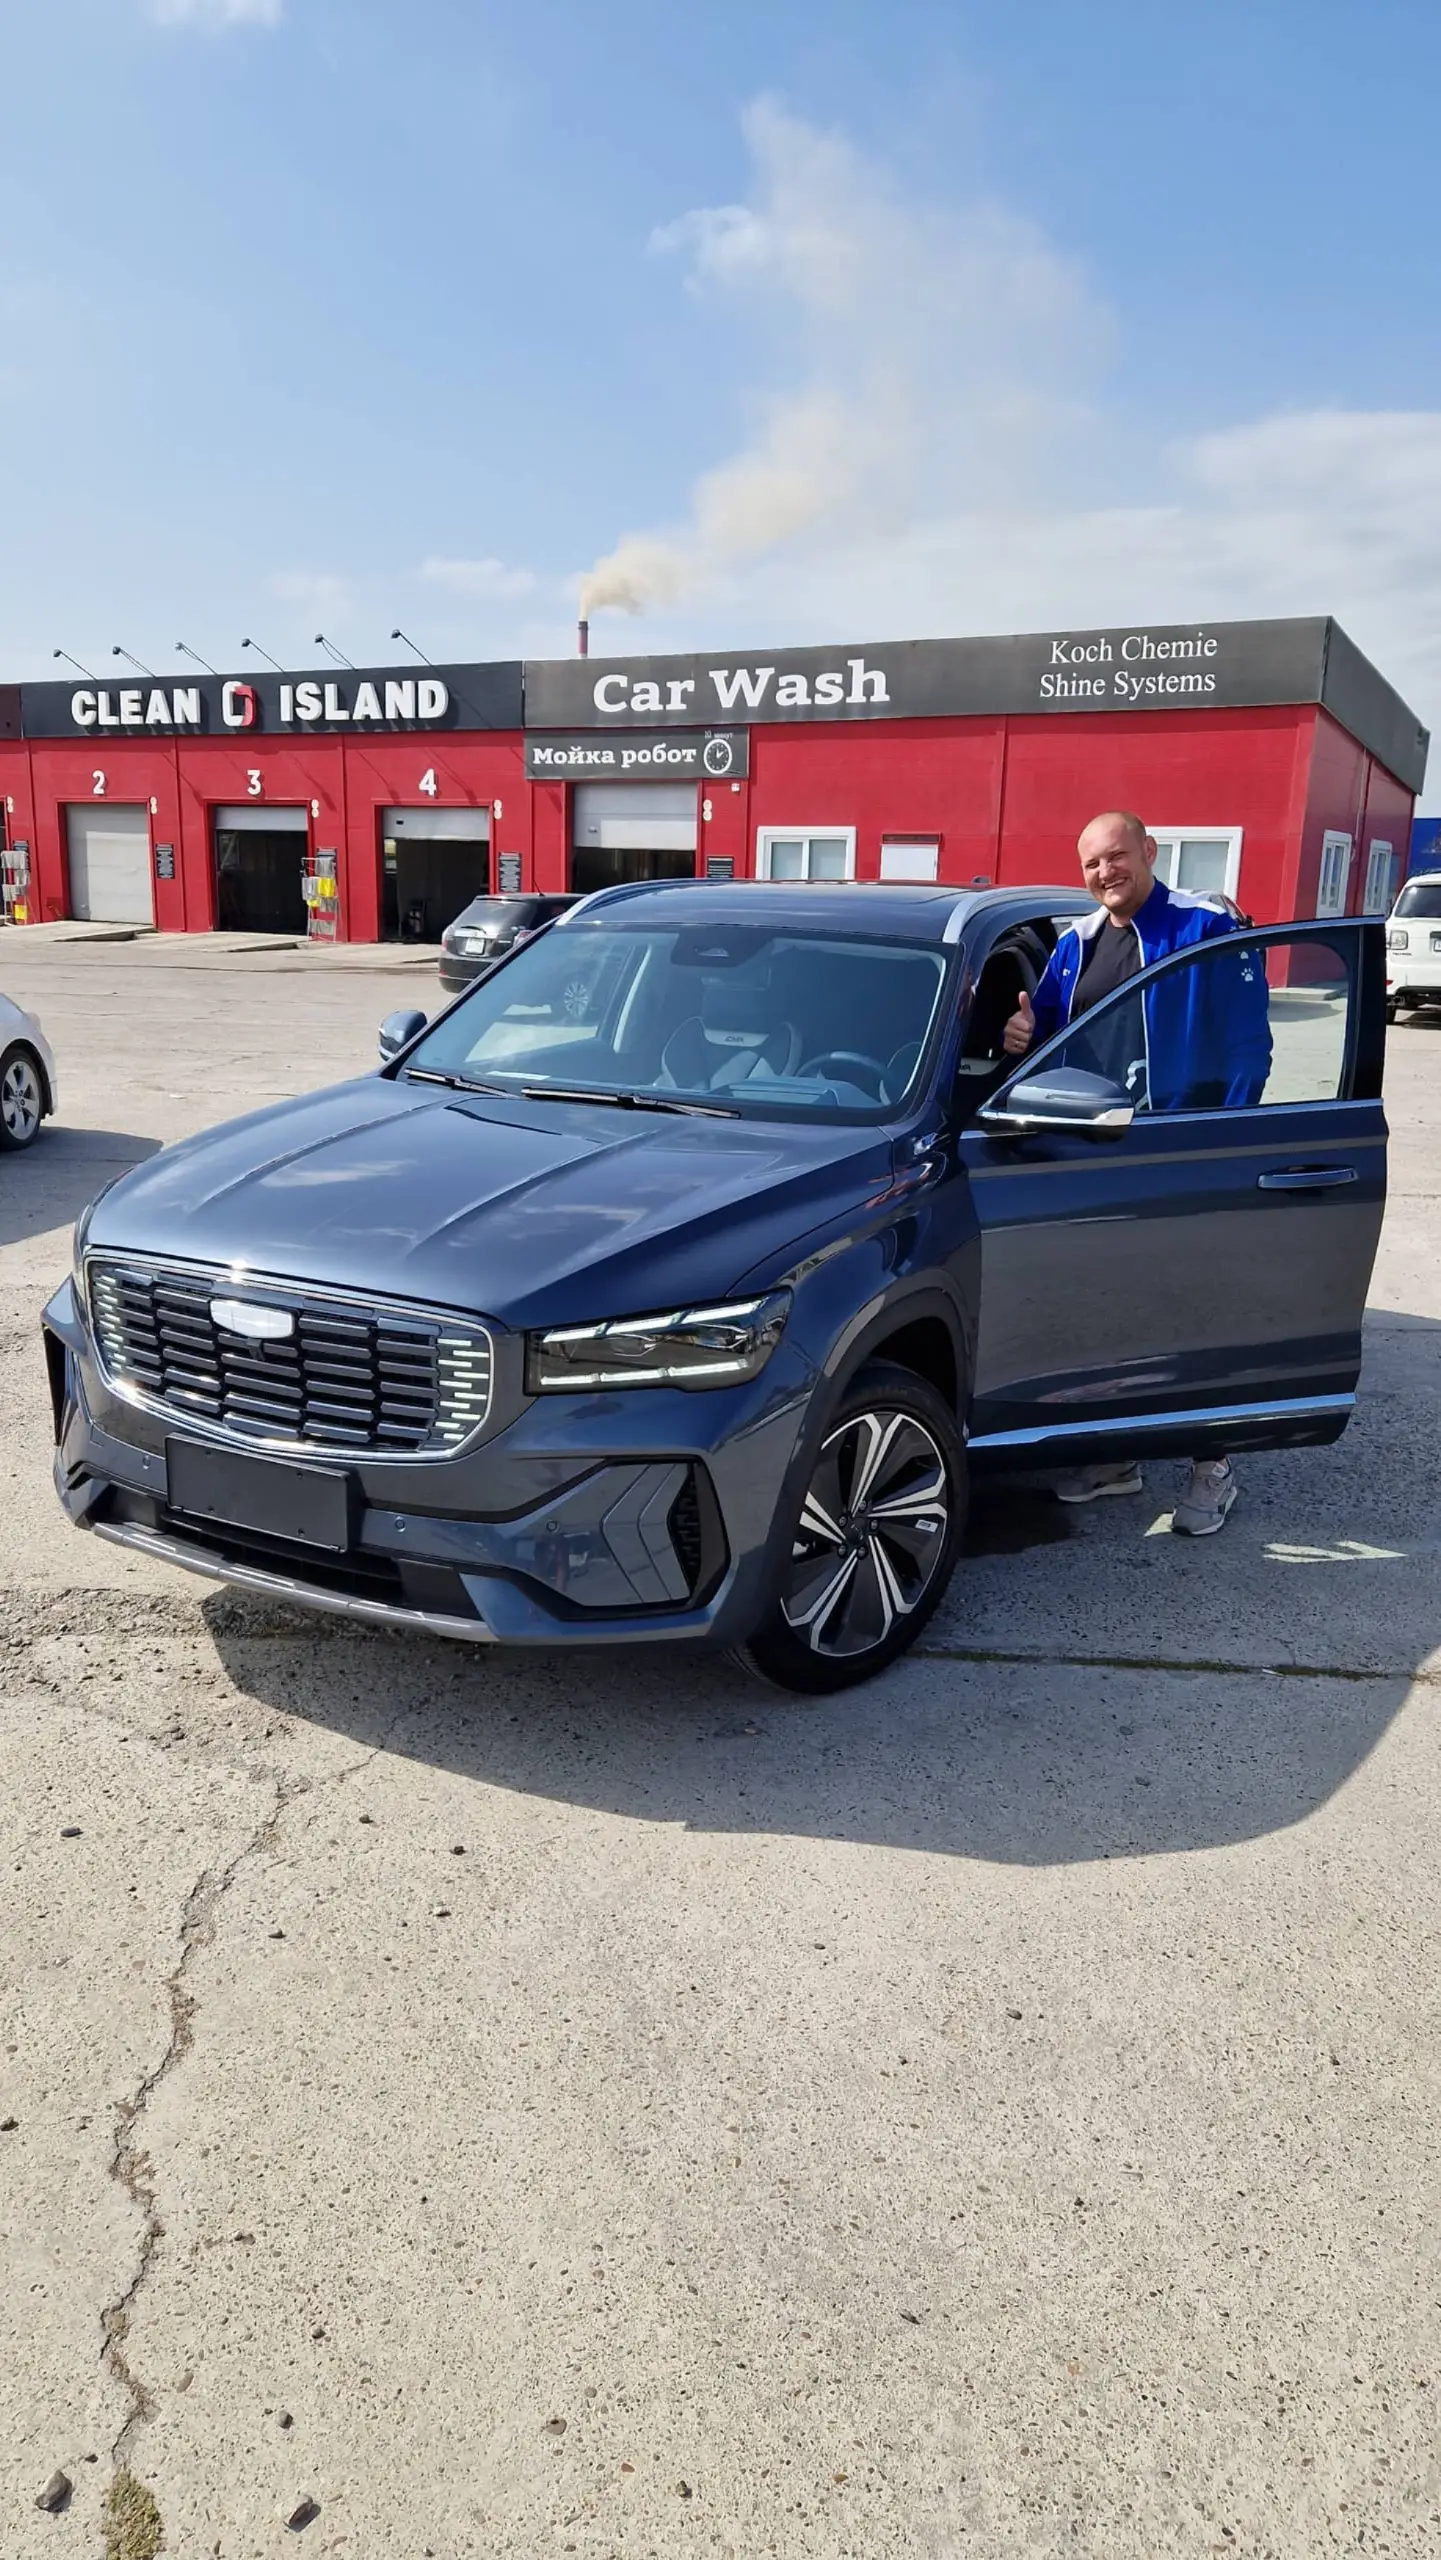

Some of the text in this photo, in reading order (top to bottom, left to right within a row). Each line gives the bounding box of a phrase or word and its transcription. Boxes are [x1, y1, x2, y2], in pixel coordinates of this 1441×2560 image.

[1049, 632, 1218, 664] Koch Chemie
[593, 658, 890, 713] Car Wash
[1039, 669, 1216, 700] Shine Systems
[71, 687, 201, 726] CLEAN
[280, 679, 450, 723] ISLAND
[532, 743, 697, 768] Мойка робот
[92, 770, 105, 795] 2
[247, 769, 261, 795] 3
[418, 768, 437, 796] 4
